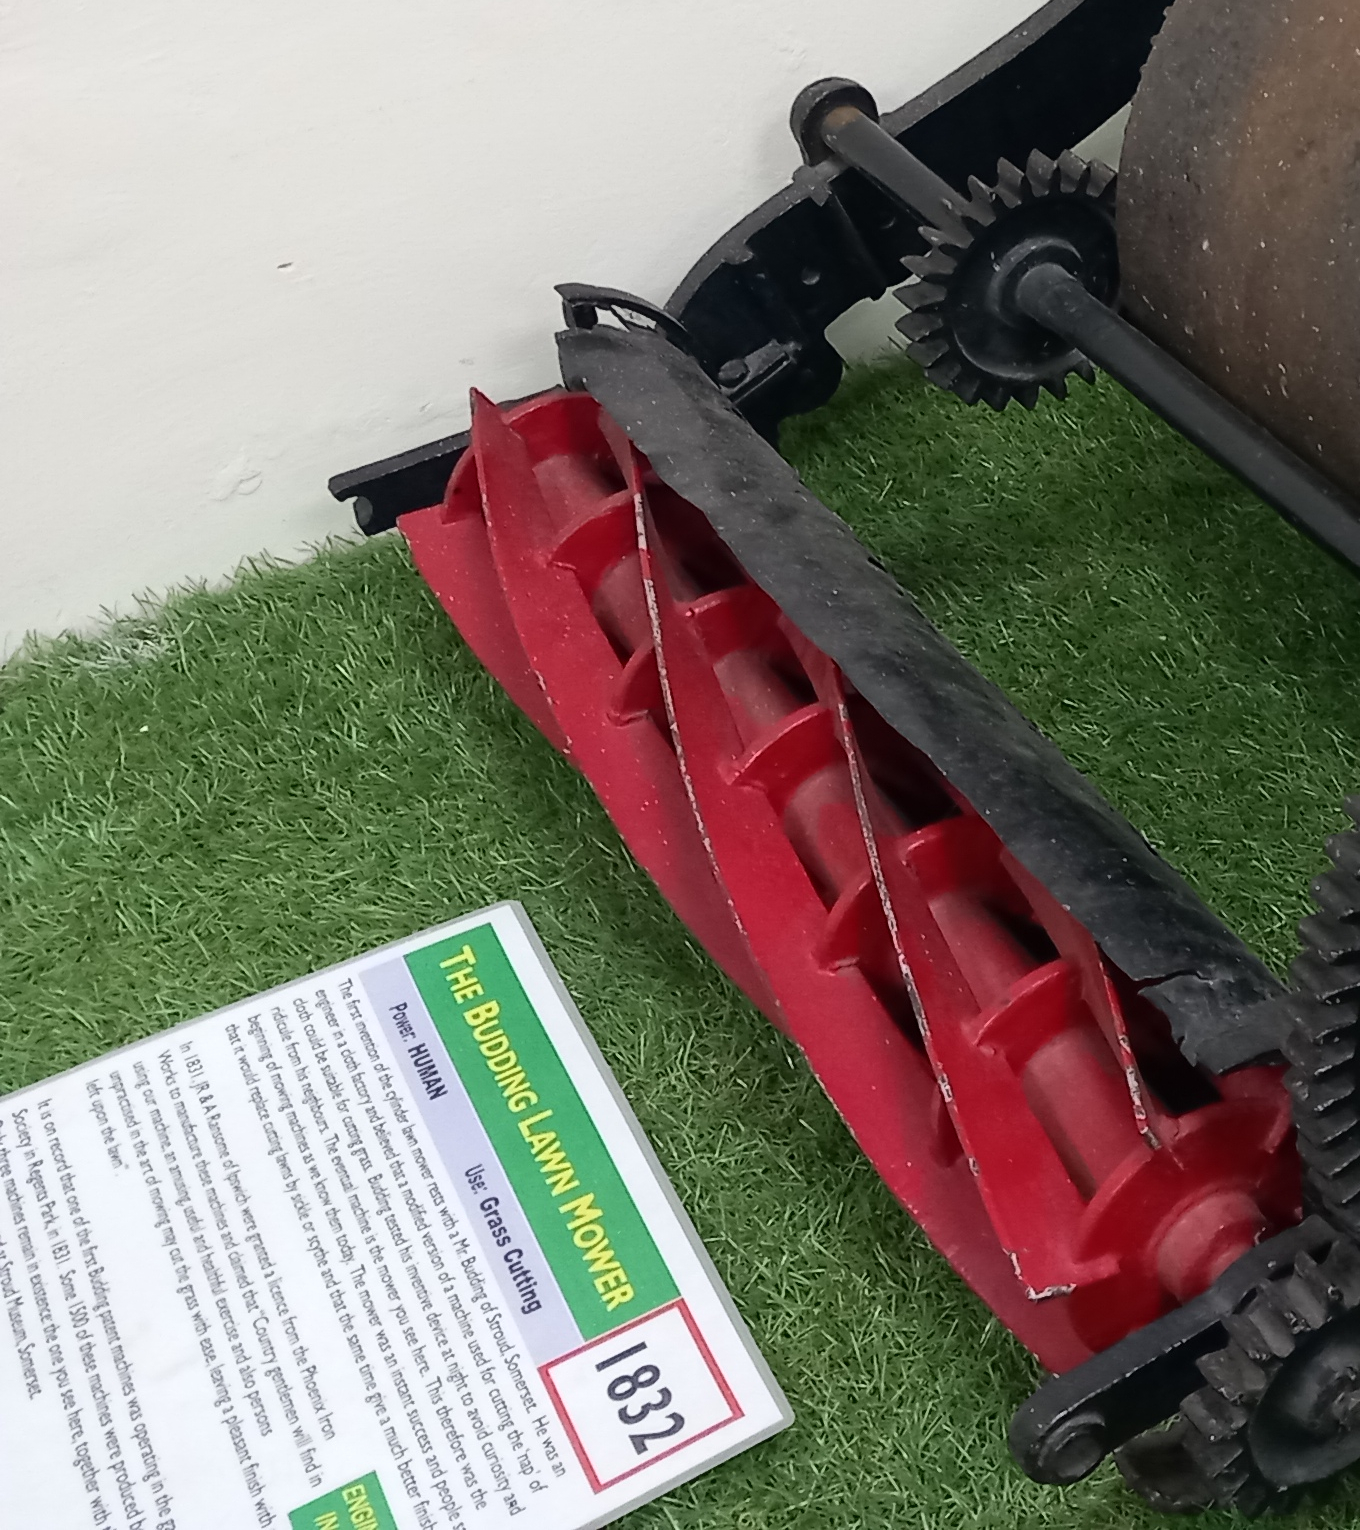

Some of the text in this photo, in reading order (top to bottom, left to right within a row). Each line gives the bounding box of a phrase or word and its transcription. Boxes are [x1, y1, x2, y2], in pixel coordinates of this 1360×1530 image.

[337, 976, 354, 1000] The
[313, 988, 340, 1028] engineer
[345, 998, 363, 1021] first
[354, 1020, 380, 1062] invention
[339, 1048, 361, 1073] cloth
[350, 1070, 373, 1105] factory
[377, 1072, 393, 1091] the
[364, 1104, 384, 1124] and
[382, 1089, 409, 1123] cylinder
[371, 1120, 401, 1161] believed
[400, 1123, 418, 1148] lawn
[440, 944, 634, 1311] THE BUDDING LAWN MOWER
[388, 1159, 406, 1182] that
[389, 1002, 542, 1315] Power: HUMAN Use: Grass Cutting
[410, 1146, 434, 1180] mower
[400, 1187, 432, 1232] modified
[426, 1180, 445, 1207] rests
[437, 1205, 459, 1231] with
[421, 1230, 445, 1271] version
[460, 1255, 488, 1303] Budding
[446, 1292, 474, 1339] machine
[484, 1312, 515, 1357] Stroud,
[466, 1338, 492, 1368] used
[479, 1365, 496, 1385] for
[503, 1352, 537, 1414] Somerset.
[487, 1387, 515, 1432] cutting
[595, 1341, 685, 1456] 1832
[506, 1428, 524, 1452] the
[541, 1435, 559, 1461] was
[516, 1447, 541, 1475] 'nap'
